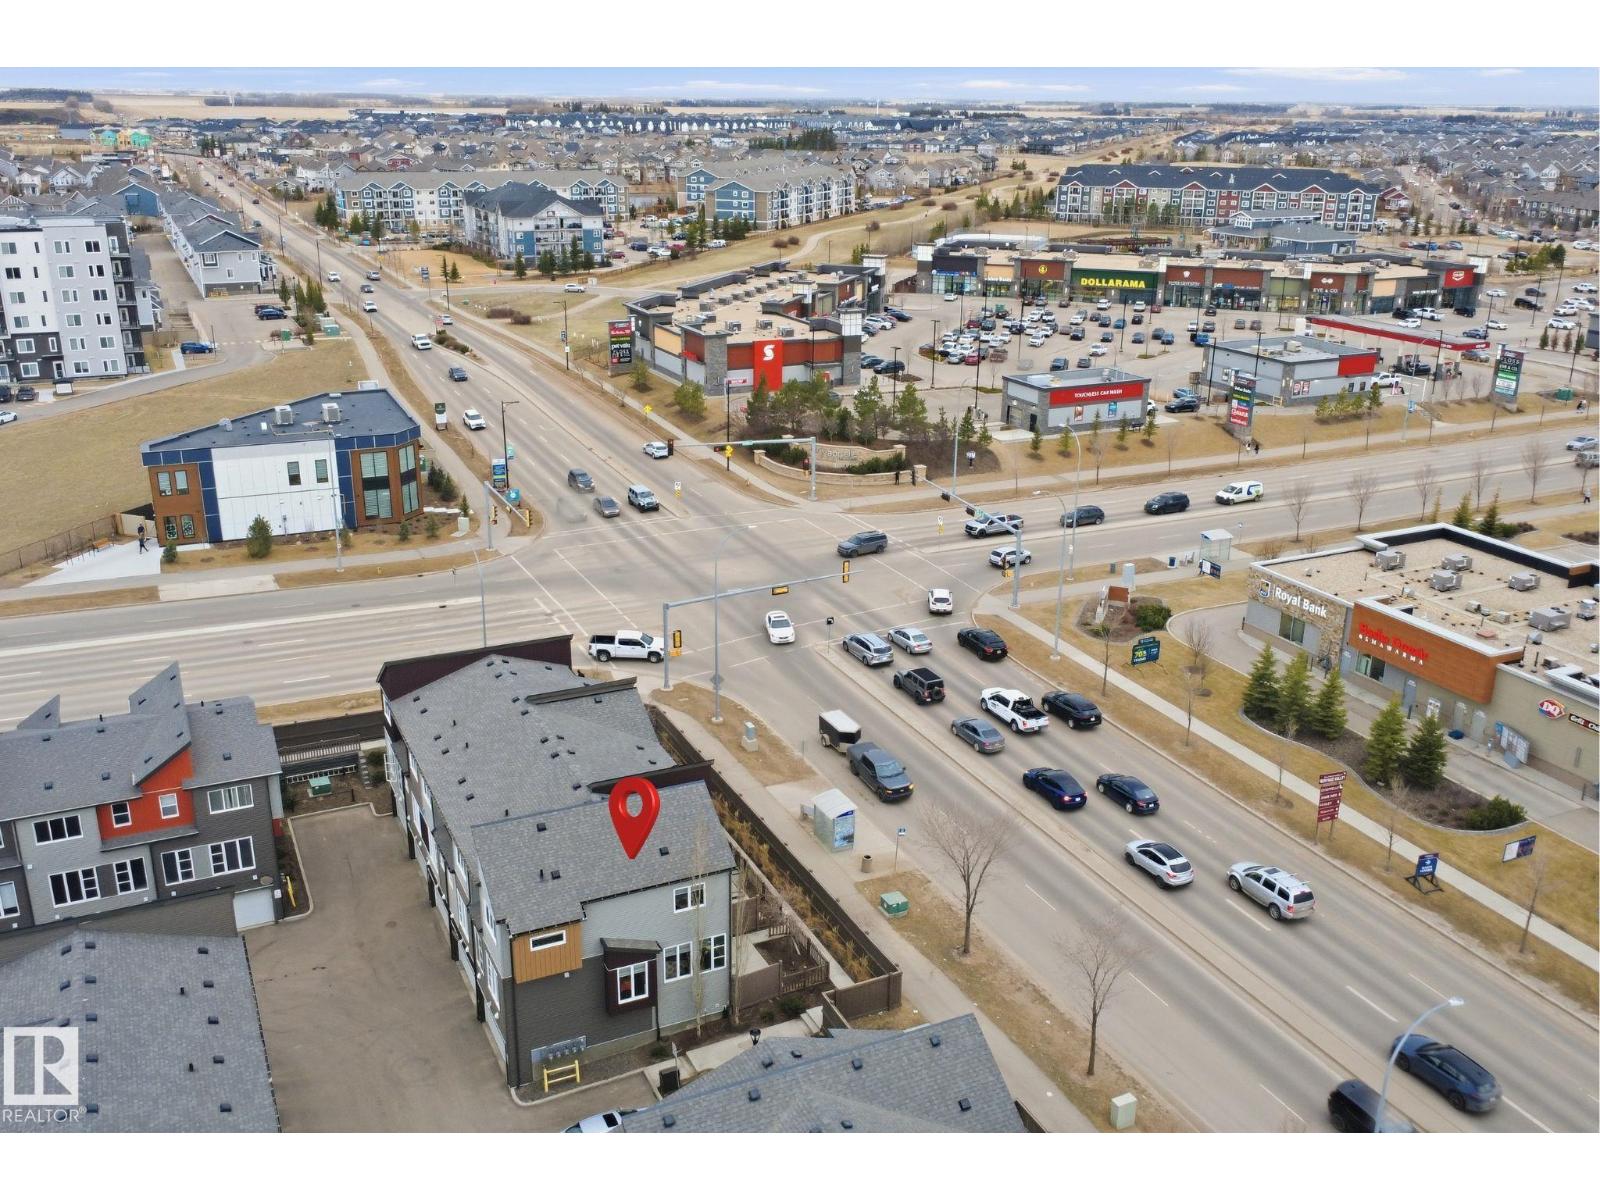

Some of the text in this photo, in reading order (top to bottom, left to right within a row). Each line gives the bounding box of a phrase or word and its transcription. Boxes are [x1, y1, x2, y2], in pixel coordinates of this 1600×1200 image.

[1080, 277, 1146, 289] DOLLARAMA
[1275, 586, 1328, 619] Royal Bank
[1543, 702, 1560, 716] DQ
